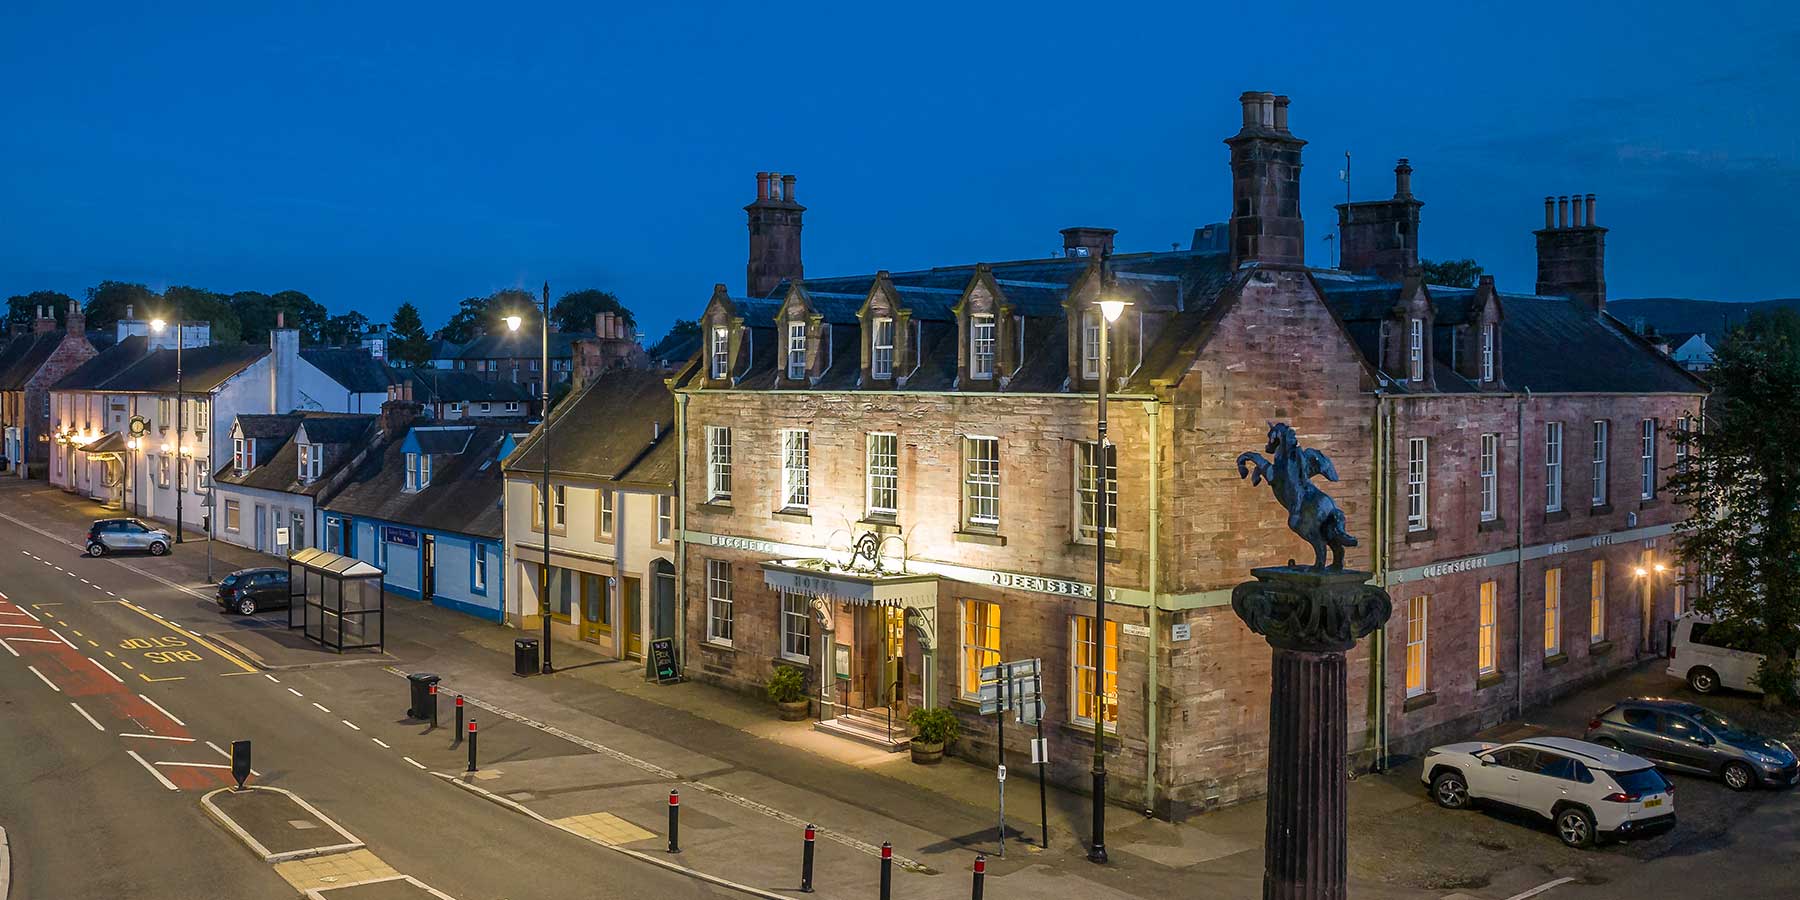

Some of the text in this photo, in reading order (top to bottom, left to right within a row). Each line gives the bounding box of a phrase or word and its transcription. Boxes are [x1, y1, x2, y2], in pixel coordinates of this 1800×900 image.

[1423, 556, 1487, 578] QUEENSBERRY
[992, 573, 1117, 601] QUEENSBERY
[120, 636, 187, 650] STOP
[144, 650, 203, 664] BUS
